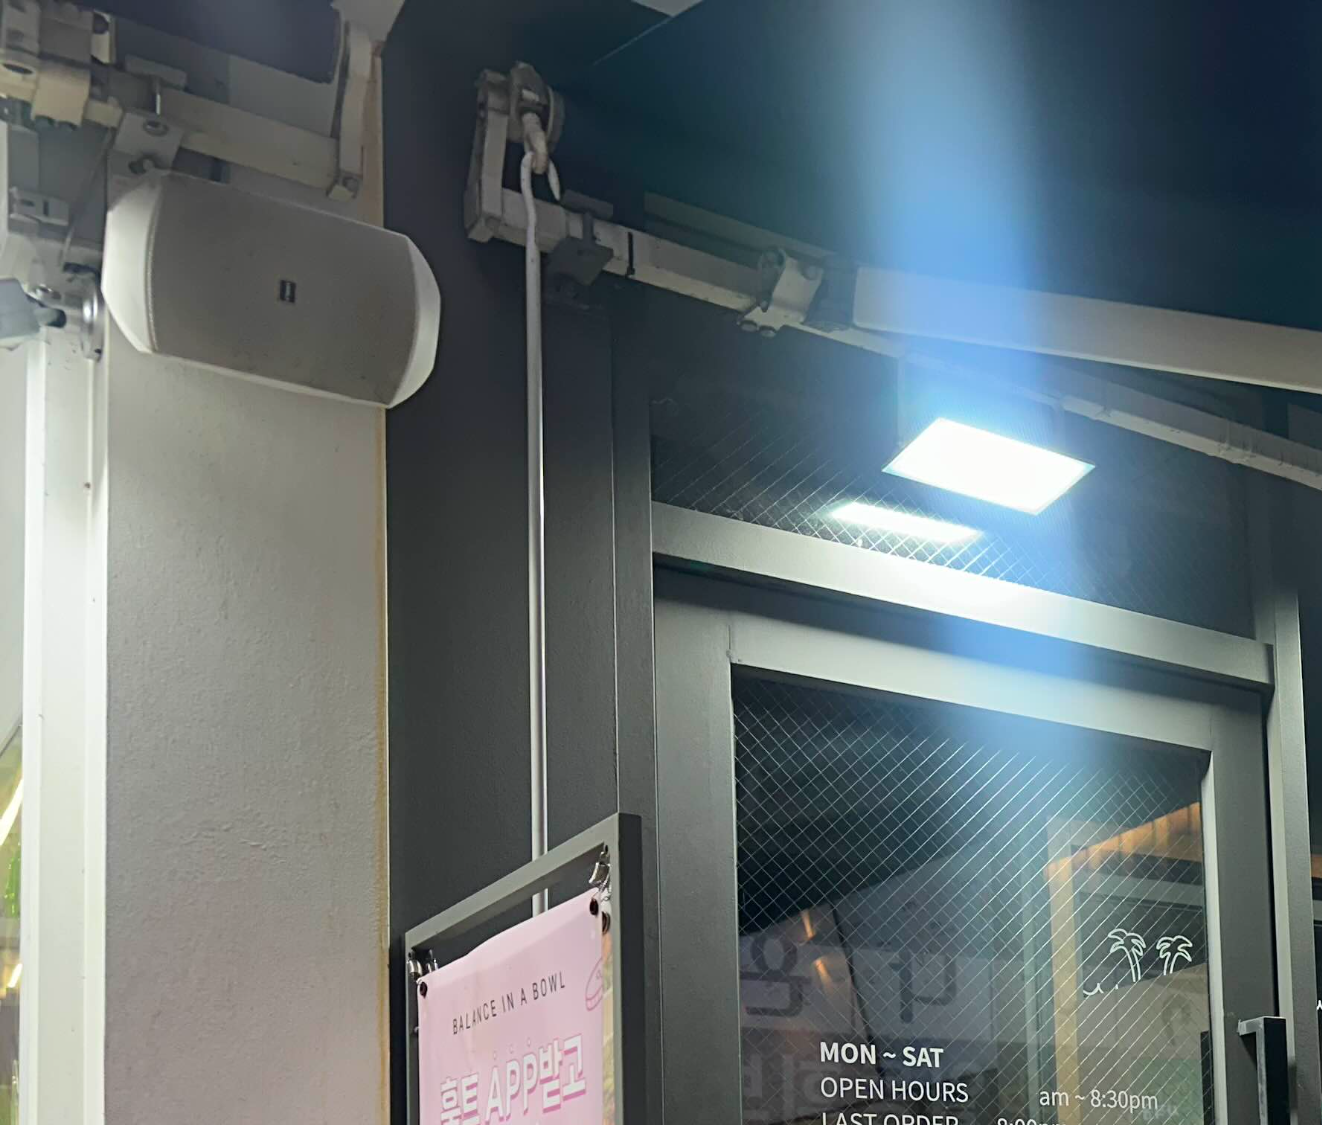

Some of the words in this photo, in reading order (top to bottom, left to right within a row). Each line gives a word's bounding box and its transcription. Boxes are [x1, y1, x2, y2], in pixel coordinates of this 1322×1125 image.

[452, 1006, 497, 1035] BALANCE
[502, 992, 514, 1013] IN
[520, 988, 528, 1006] A
[533, 971, 566, 1001] BOWL
[820, 1042, 876, 1065] MON
[903, 1046, 944, 1068] SAT
[820, 1077, 884, 1100] OPEN
[892, 1080, 969, 1102] HOURS
[1039, 1091, 1070, 1106] am
[1090, 1089, 1158, 1113] 8:30pm
